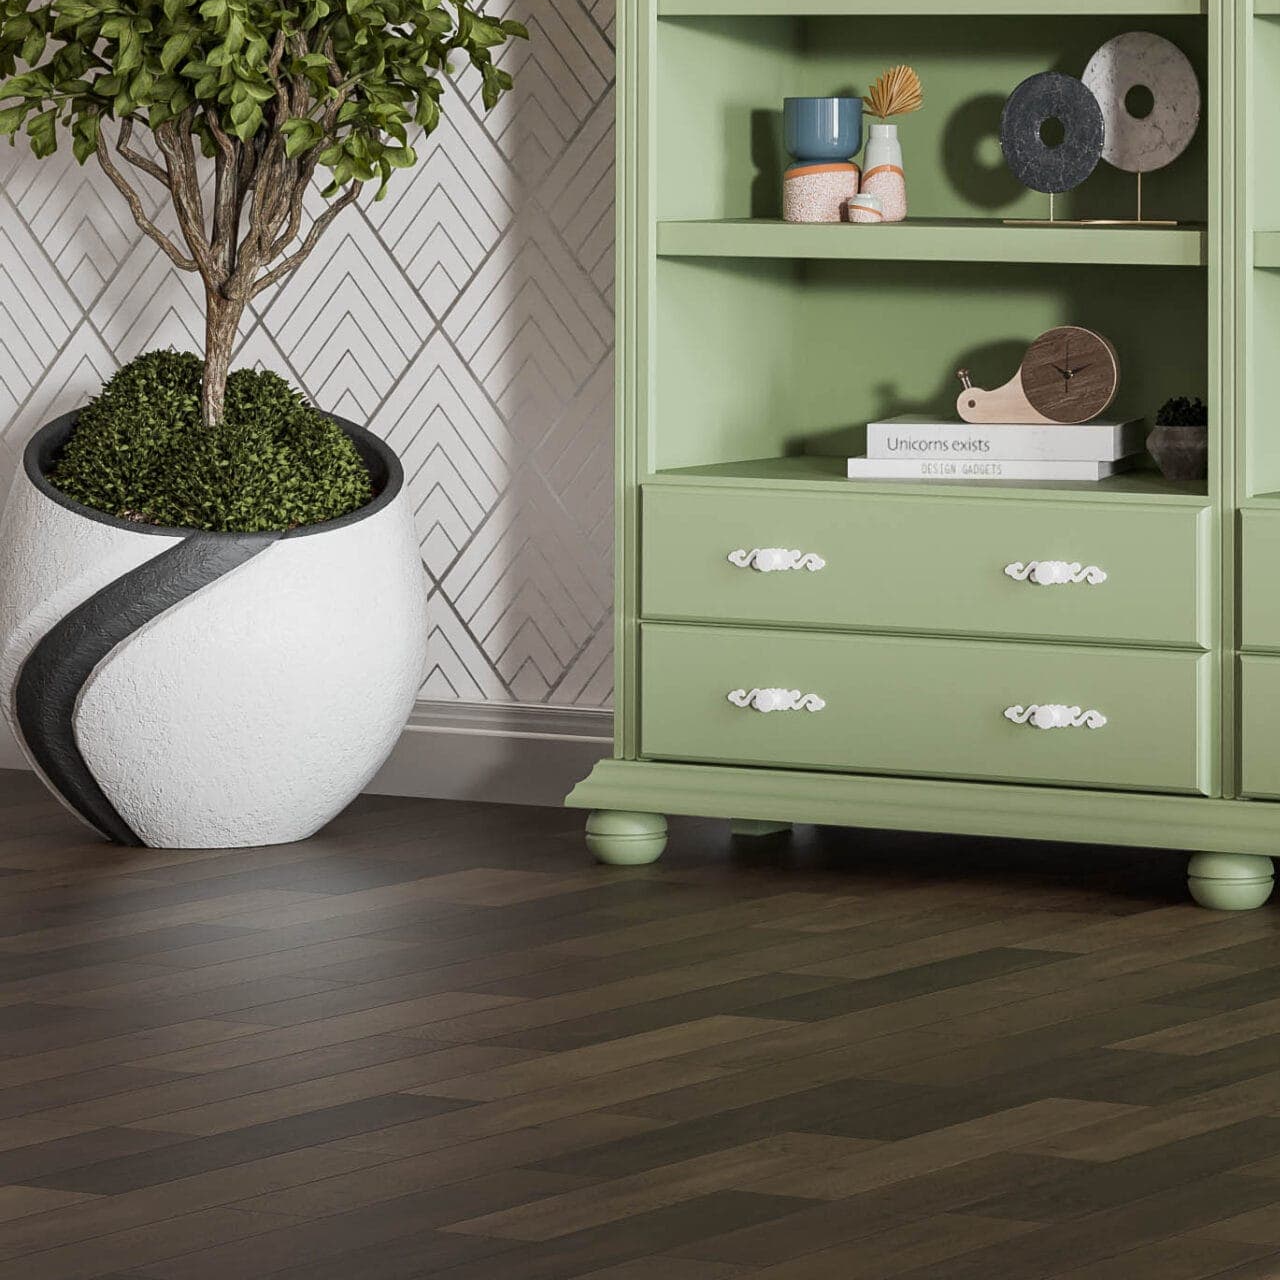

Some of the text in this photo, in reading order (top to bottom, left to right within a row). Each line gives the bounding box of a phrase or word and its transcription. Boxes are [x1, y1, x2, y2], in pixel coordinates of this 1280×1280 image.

[887, 437, 990, 452] Unicorns exists
[921, 463, 1002, 475] DESIGN GADGETS
